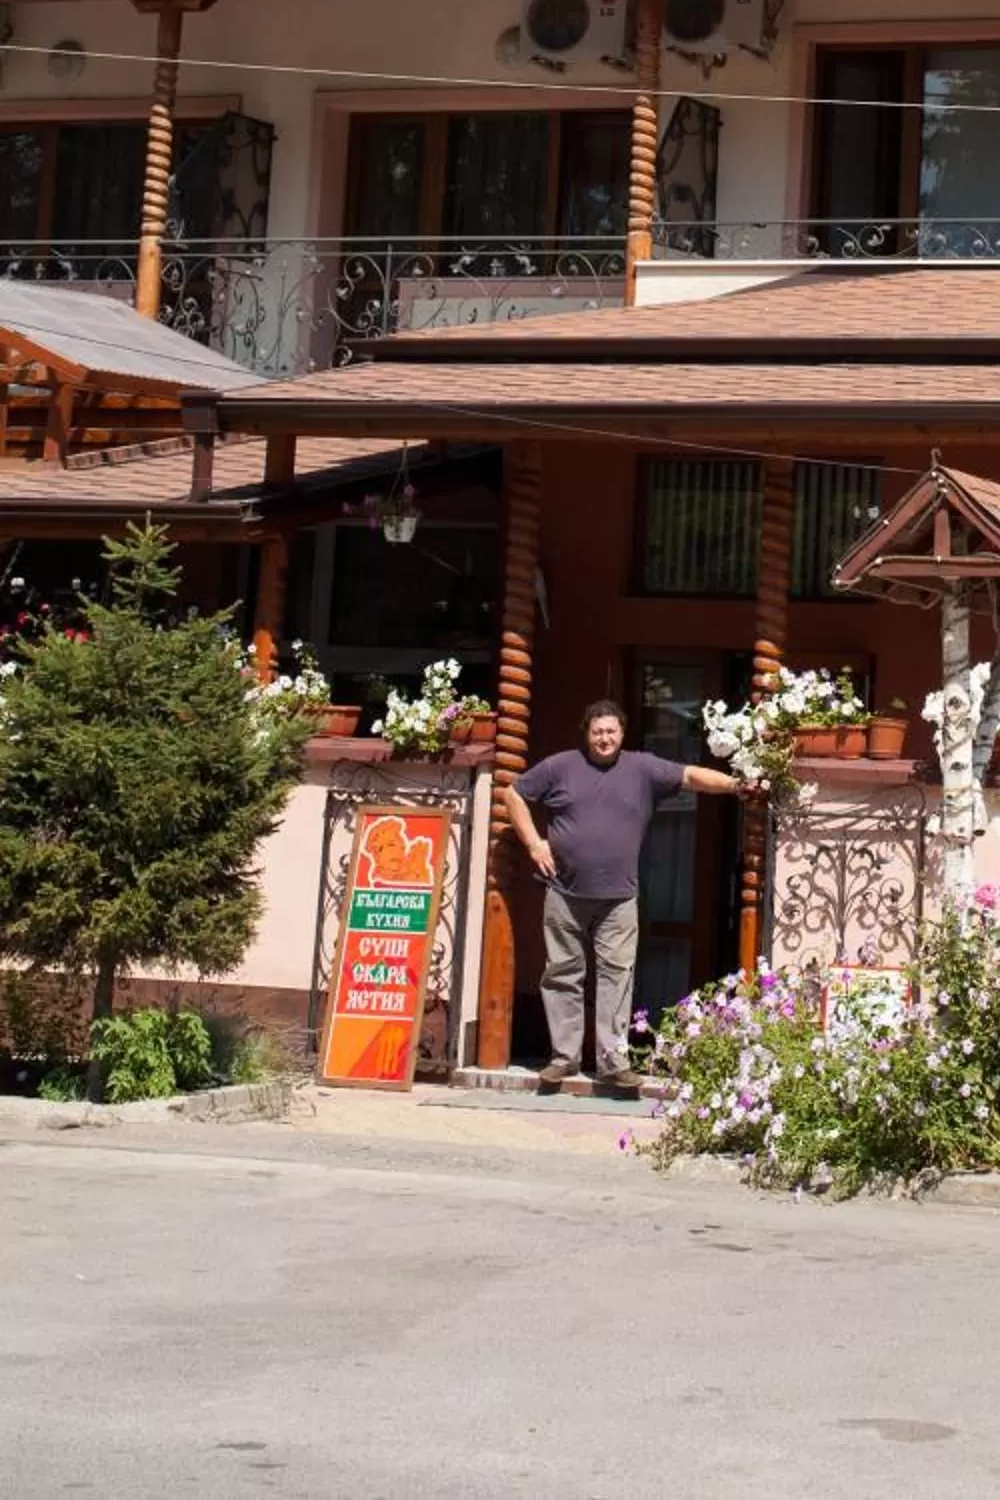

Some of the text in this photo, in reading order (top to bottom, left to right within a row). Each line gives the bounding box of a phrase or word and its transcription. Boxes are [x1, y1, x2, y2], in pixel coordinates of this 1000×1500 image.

[355, 893, 425, 909] БЪЛГАРСКА
[359, 937, 409, 957] СУПИ
[352, 963, 408, 985] СКАРА
[345, 989, 406, 1012] ЯСТИЯ
